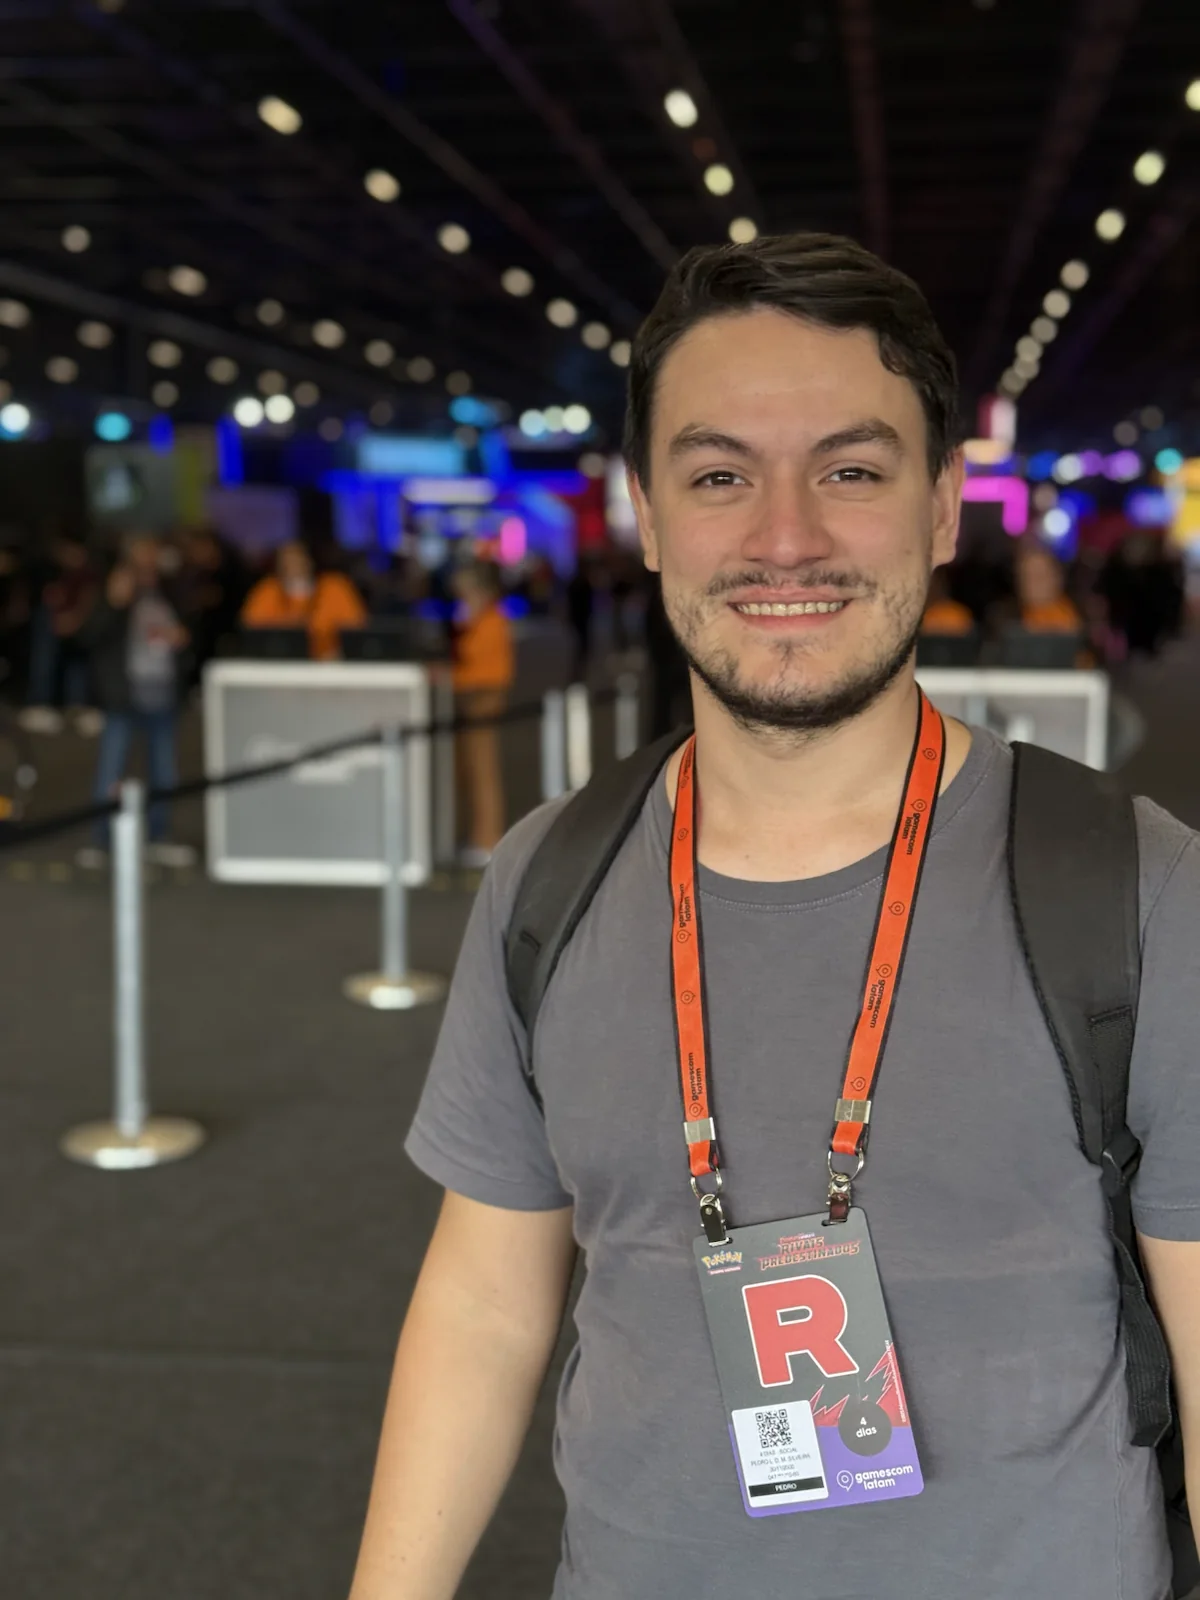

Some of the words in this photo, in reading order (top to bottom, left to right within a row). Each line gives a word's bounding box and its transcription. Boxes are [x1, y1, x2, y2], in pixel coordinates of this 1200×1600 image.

[867, 983, 878, 1010] latam
[870, 979, 886, 1028] gamescom
[688, 1052, 699, 1101] gamescom
[741, 1274, 860, 1388] R
[860, 1416, 867, 1425] 4
[855, 1426, 877, 1438] dias
[855, 1464, 913, 1484] gamescom
[774, 1482, 797, 1492] PEDRO
[863, 1478, 896, 1491] latam
